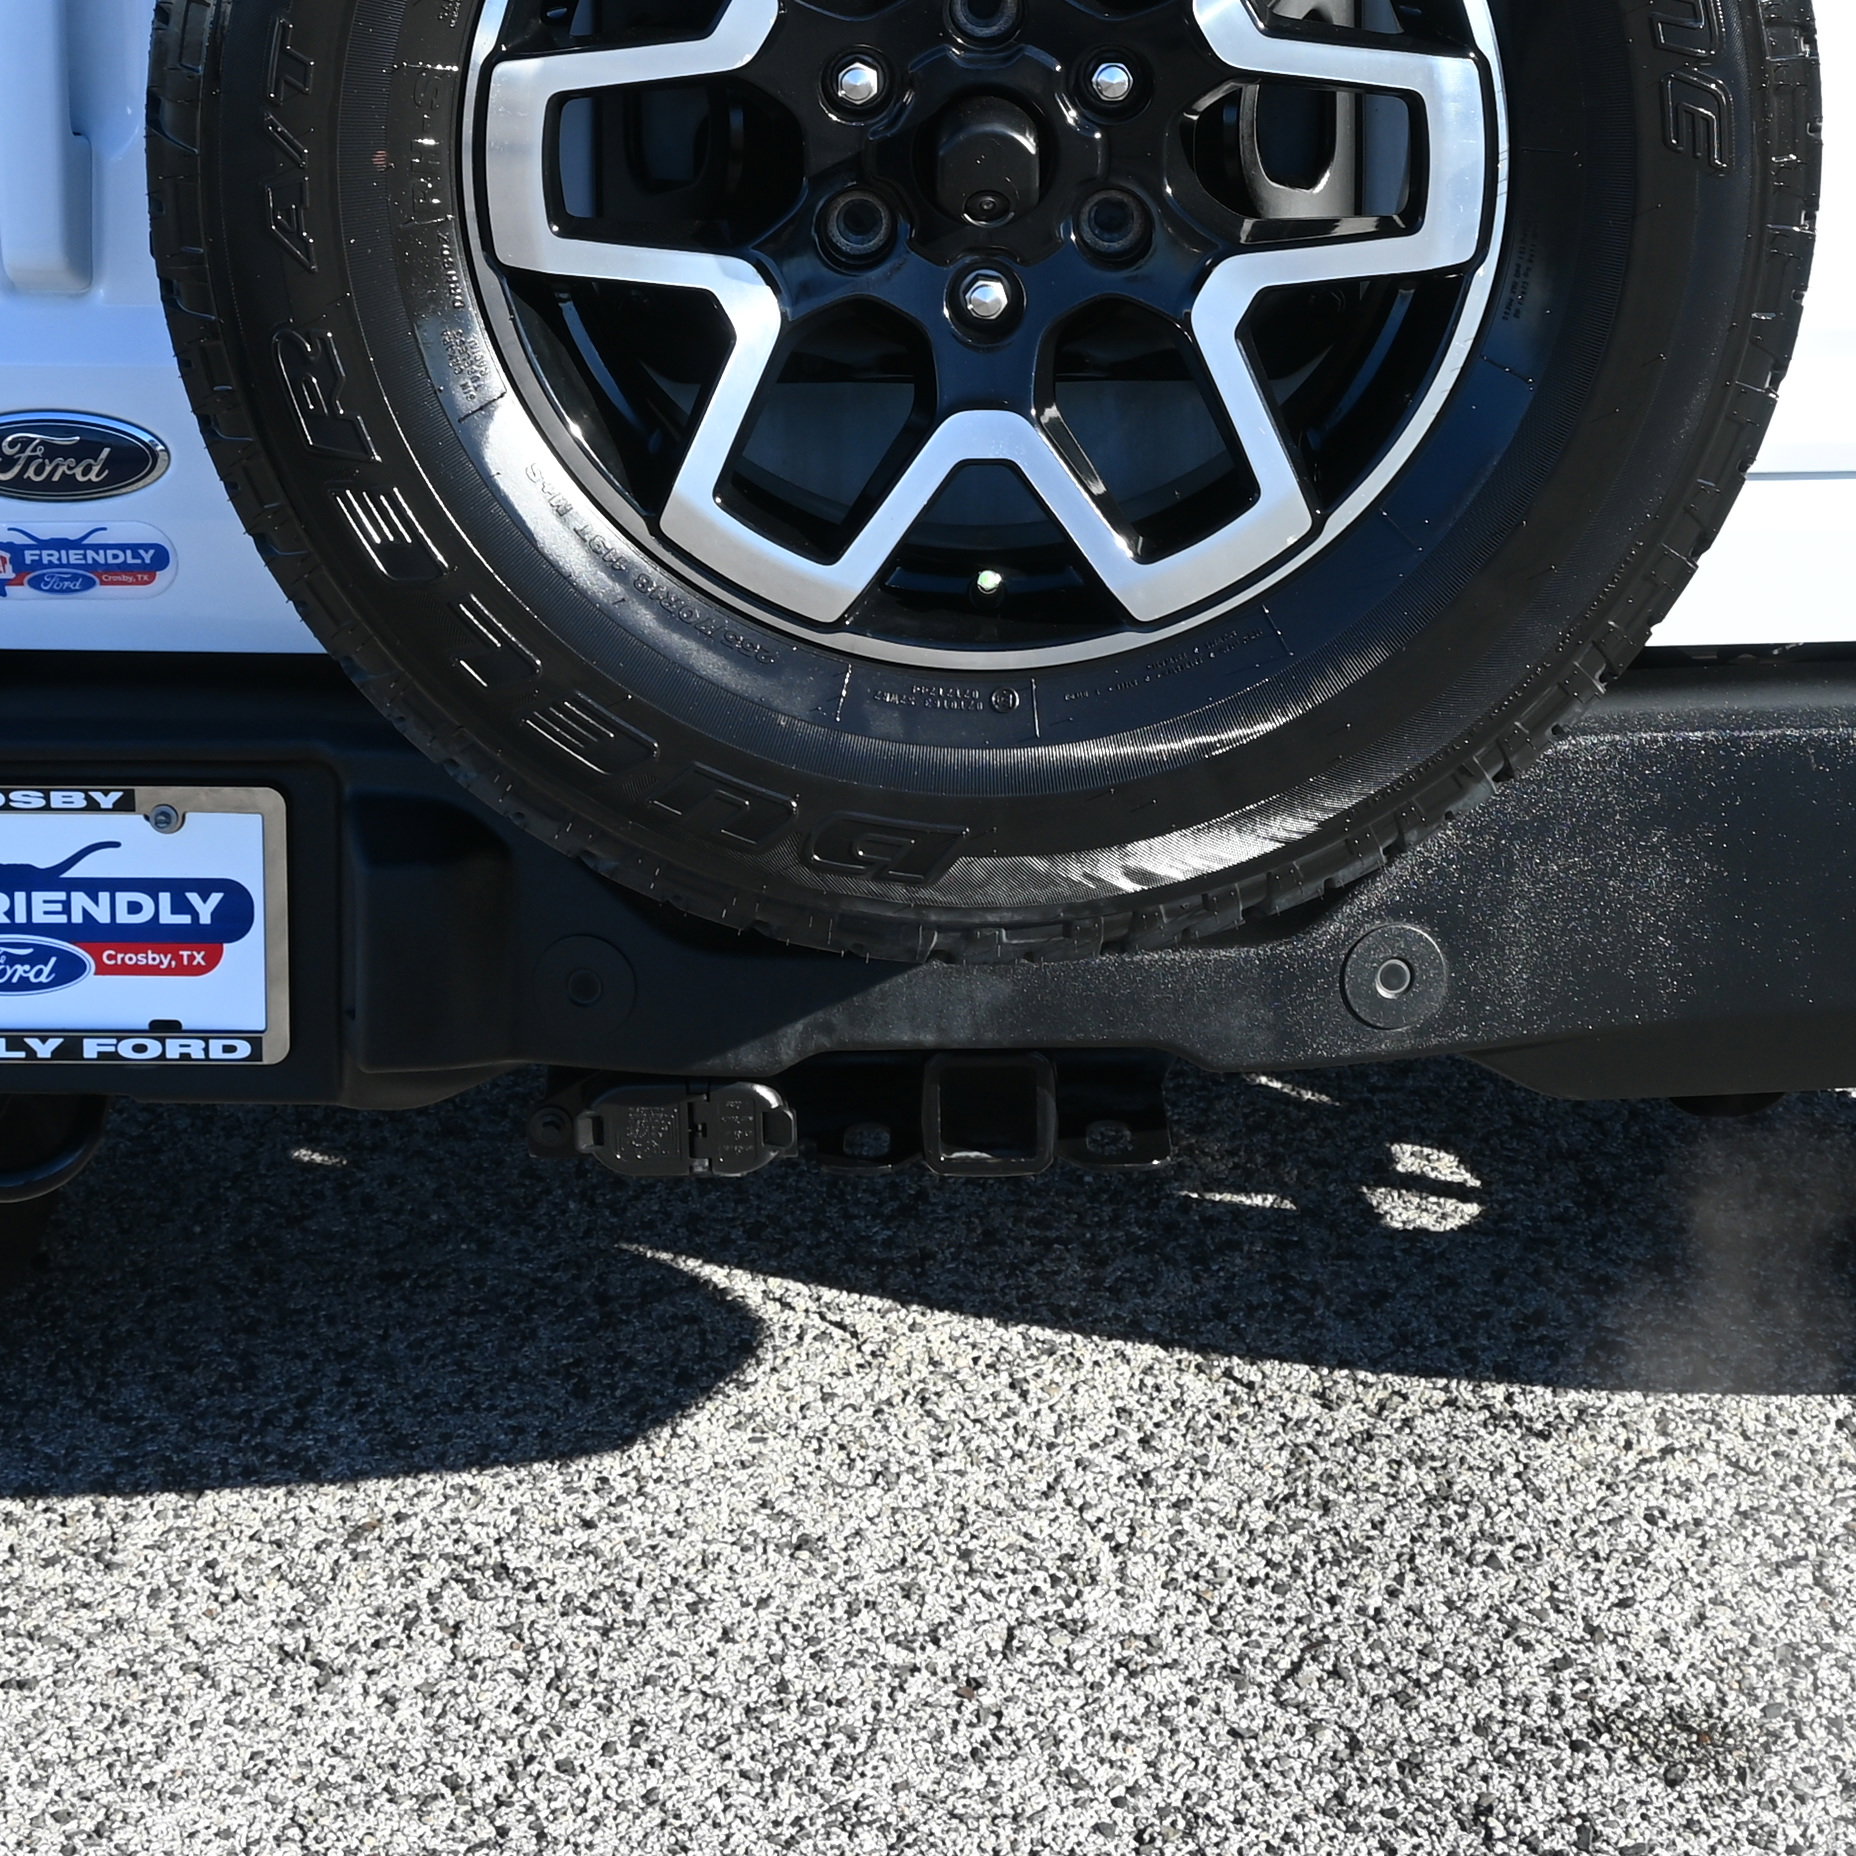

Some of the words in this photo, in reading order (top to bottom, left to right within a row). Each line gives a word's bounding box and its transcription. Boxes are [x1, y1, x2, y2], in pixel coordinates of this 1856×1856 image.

[262, 14, 322, 276] A/T
[24, 549, 155, 565] FRIENDLY
[40, 573, 83, 591] Ford
[102, 574, 136, 583] Crosby,
[137, 574, 149, 582] TX
[270, 324, 970, 888] DUELER
[102, 948, 176, 969] Crosby,
[179, 949, 206, 967] TX
[82, 1037, 253, 1061] FORD
